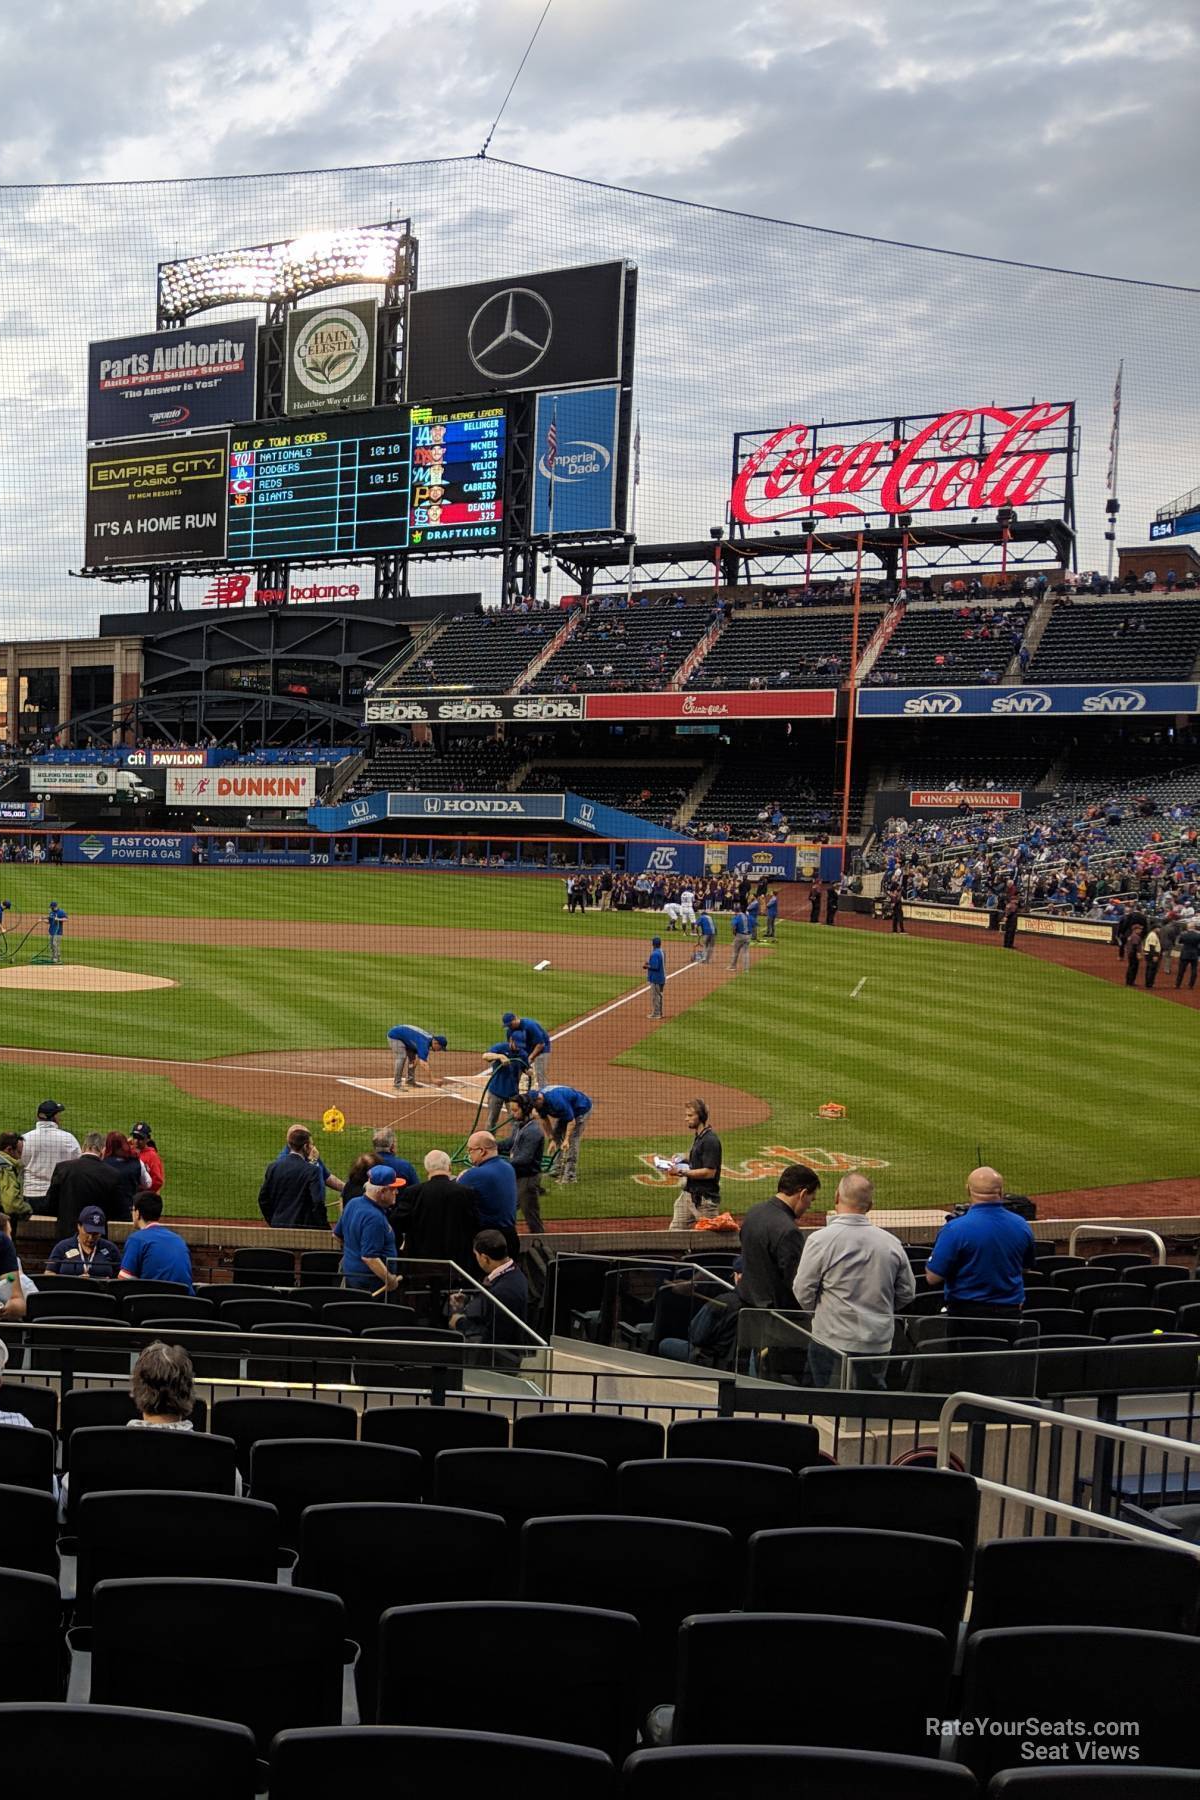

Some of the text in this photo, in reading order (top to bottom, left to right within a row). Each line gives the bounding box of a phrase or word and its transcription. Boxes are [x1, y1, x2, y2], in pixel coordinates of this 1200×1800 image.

[314, 330, 349, 345] HAIN
[297, 337, 362, 359] CELESTIAL
[100, 339, 245, 380] Parts Authority
[104, 363, 240, 388] Auto Parts Super Stores
[144, 384, 181, 396] Answer
[293, 393, 368, 410] Healthier Way of Life
[478, 408, 504, 417] LEADERS
[464, 419, 499, 431] BELLINGER
[232, 432, 328, 451] OUT OF TOWN SCORES
[470, 440, 498, 451] MCNEIL
[260, 448, 313, 462] NATIONALS
[259, 463, 300, 475] DODGERS
[471, 461, 497, 471] YELICH
[568, 462, 600, 475] Dade
[732, 401, 1073, 524] Coca-Cola
[97, 458, 216, 481] EMPIRE CITY
[133, 476, 177, 488] CASINO
[259, 479, 282, 489] REDS
[463, 481, 497, 492] CABRERA
[152, 489, 182, 497] RESORTS
[259, 490, 294, 502] GIANTS
[467, 502, 496, 512] DEJONG
[94, 512, 217, 537] IT'S A HOME RUN
[427, 526, 497, 540] DRAFTKINGS
[254, 583, 360, 602] new balance
[903, 696, 1139, 714] SNY SNY SNY
[127, 750, 203, 765] citi PAVILION
[217, 777, 307, 796] DUNKIN'
[443, 799, 525, 813] HONDA
[348, 814, 378, 826] HONDA
[573, 817, 596, 830] HONDA
[111, 838, 181, 848] EAST COAST
[111, 849, 182, 858] POWER & GAS
[310, 854, 329, 864] 370
[647, 846, 677, 869] RTS
